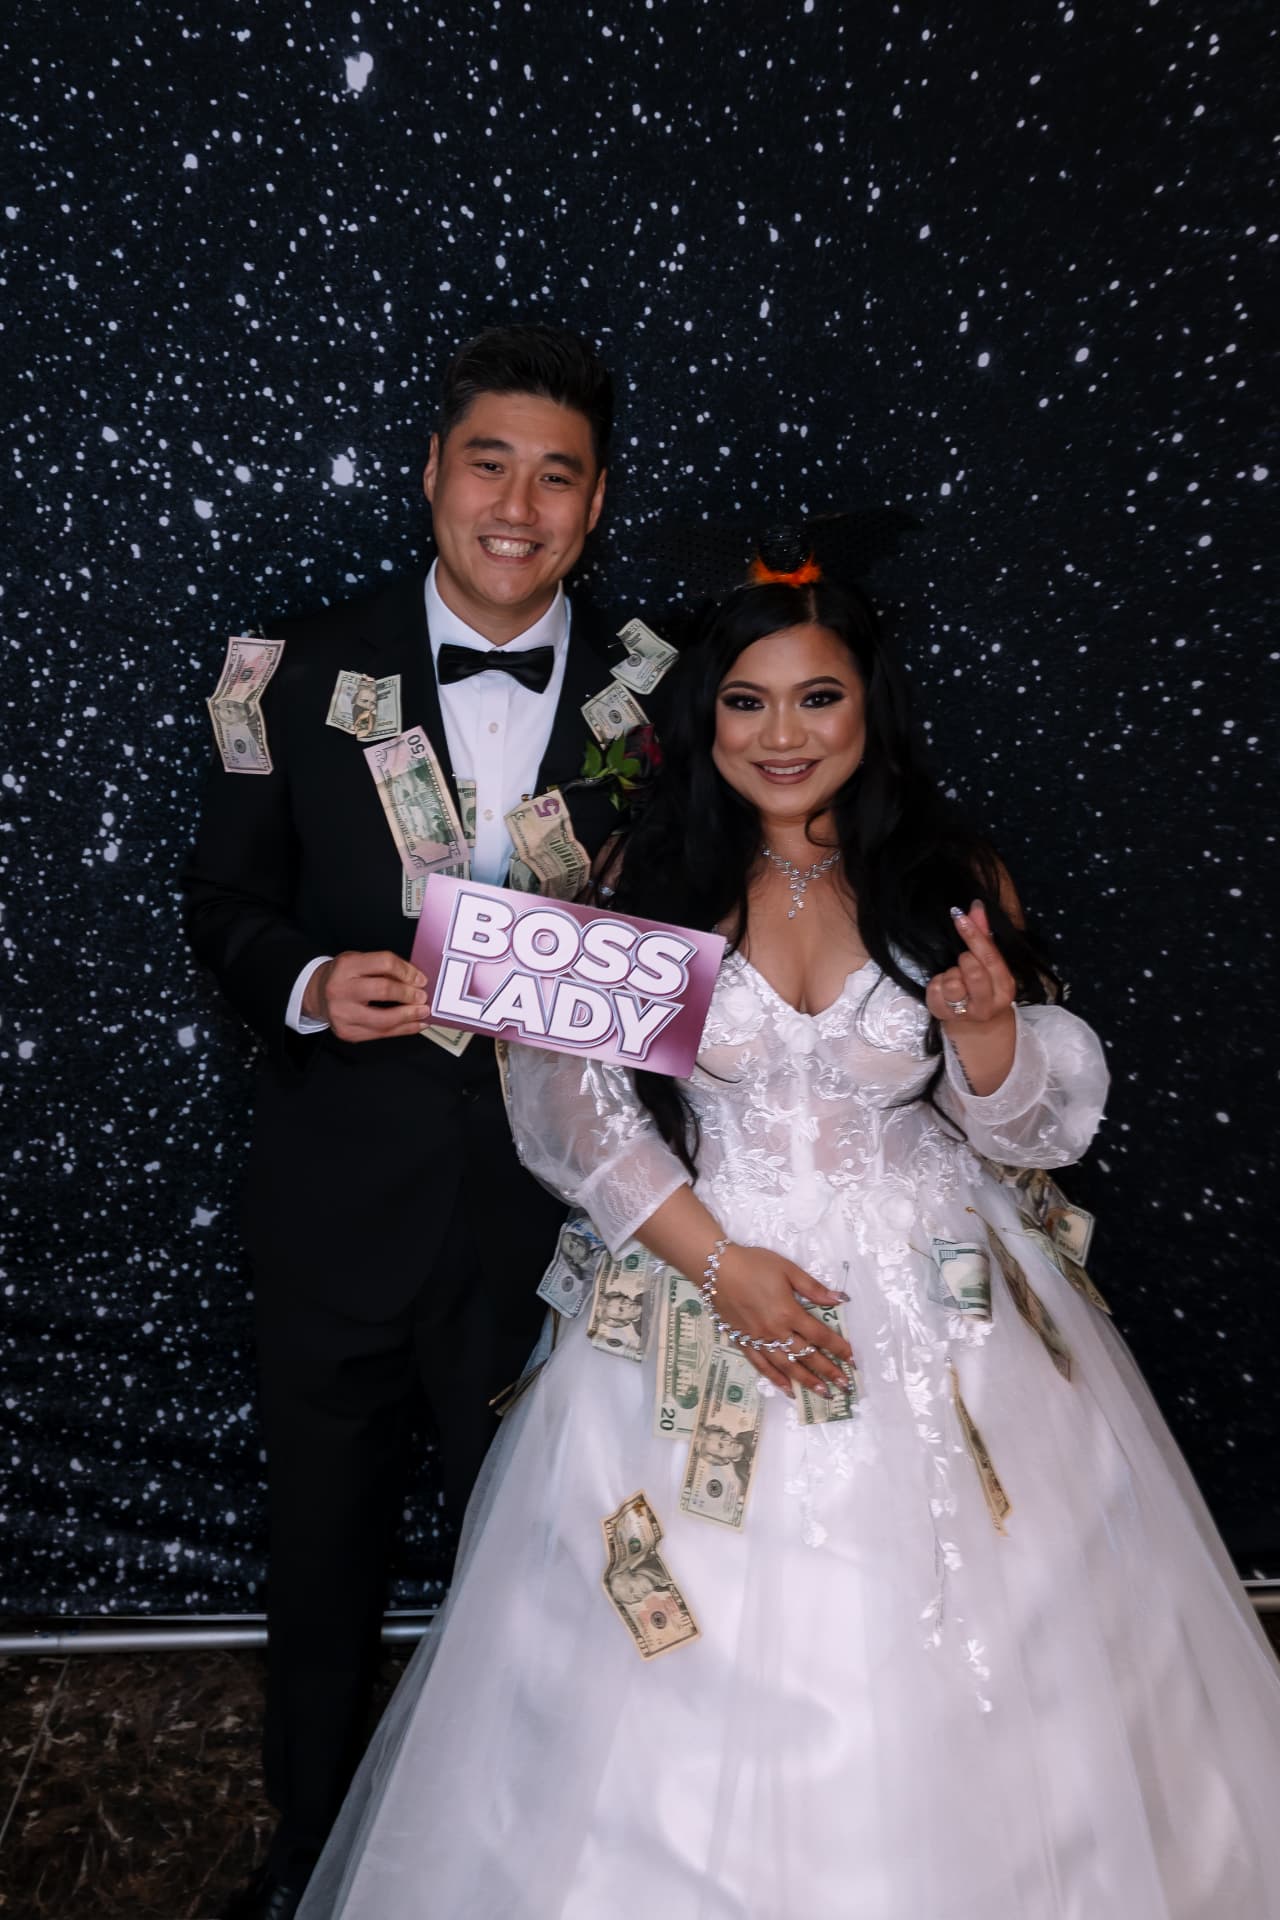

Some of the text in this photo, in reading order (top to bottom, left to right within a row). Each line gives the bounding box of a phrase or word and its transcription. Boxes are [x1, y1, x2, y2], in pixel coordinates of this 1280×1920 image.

[407, 734, 425, 755] 50
[533, 798, 560, 818] 5
[443, 889, 697, 1000] BOSS
[431, 955, 684, 1061] LADY
[659, 1407, 676, 1431] 20
